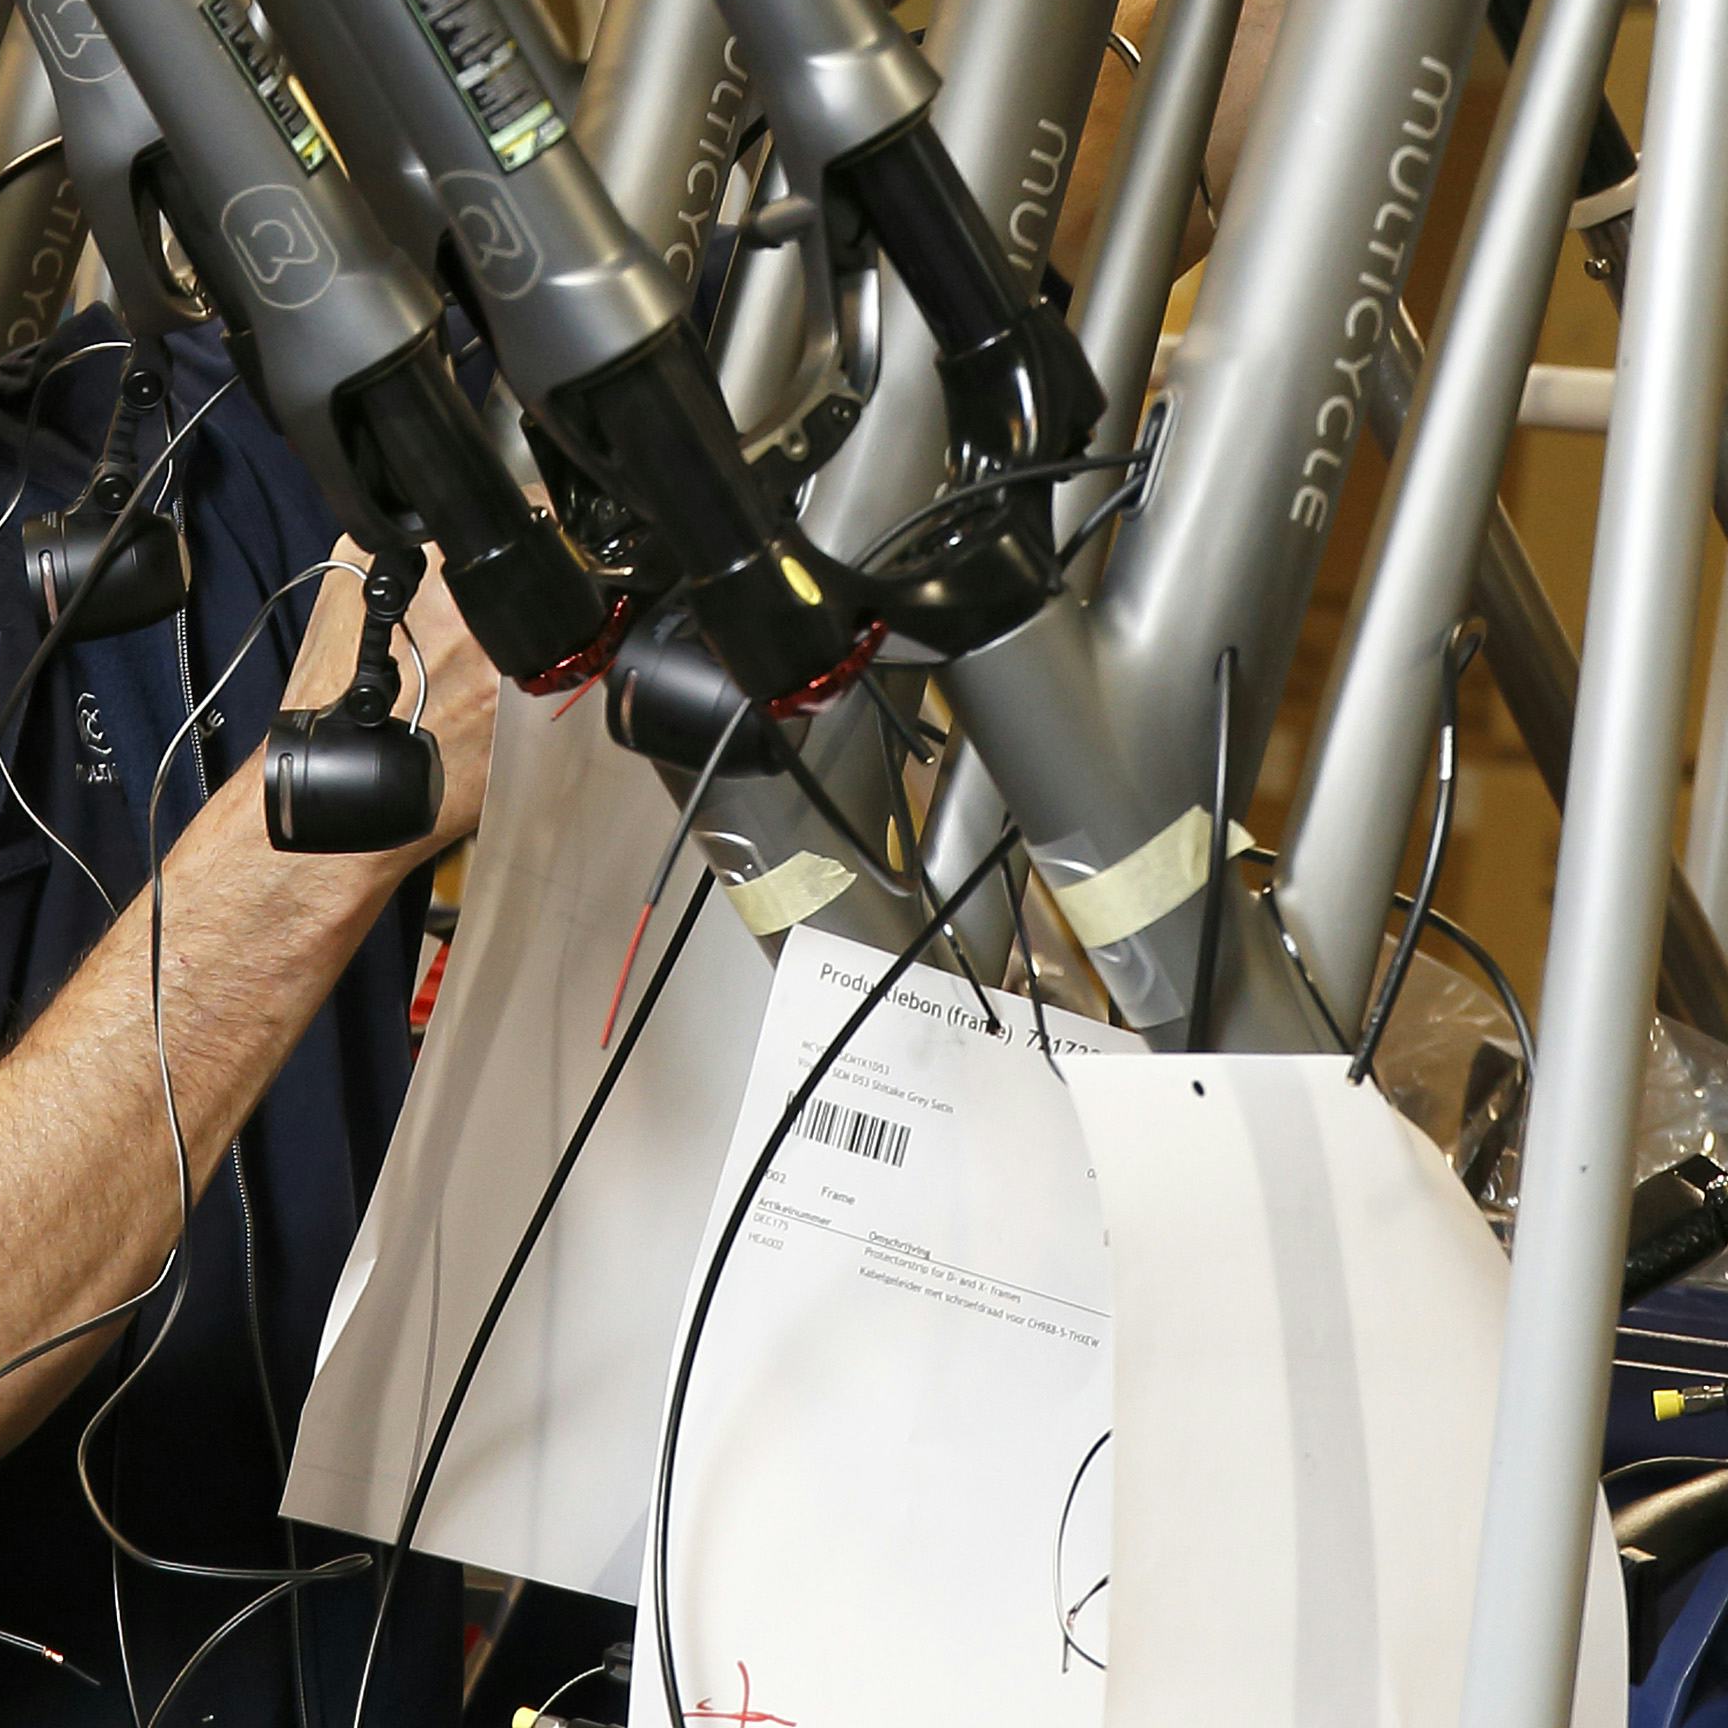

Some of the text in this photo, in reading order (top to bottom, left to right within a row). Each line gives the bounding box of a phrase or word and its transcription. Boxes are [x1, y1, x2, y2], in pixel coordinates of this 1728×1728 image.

[663, 35, 749, 284] ULTICYC
[1289, 56, 1453, 533] MULTICYCLE
[821, 1184, 856, 1205] Frame
